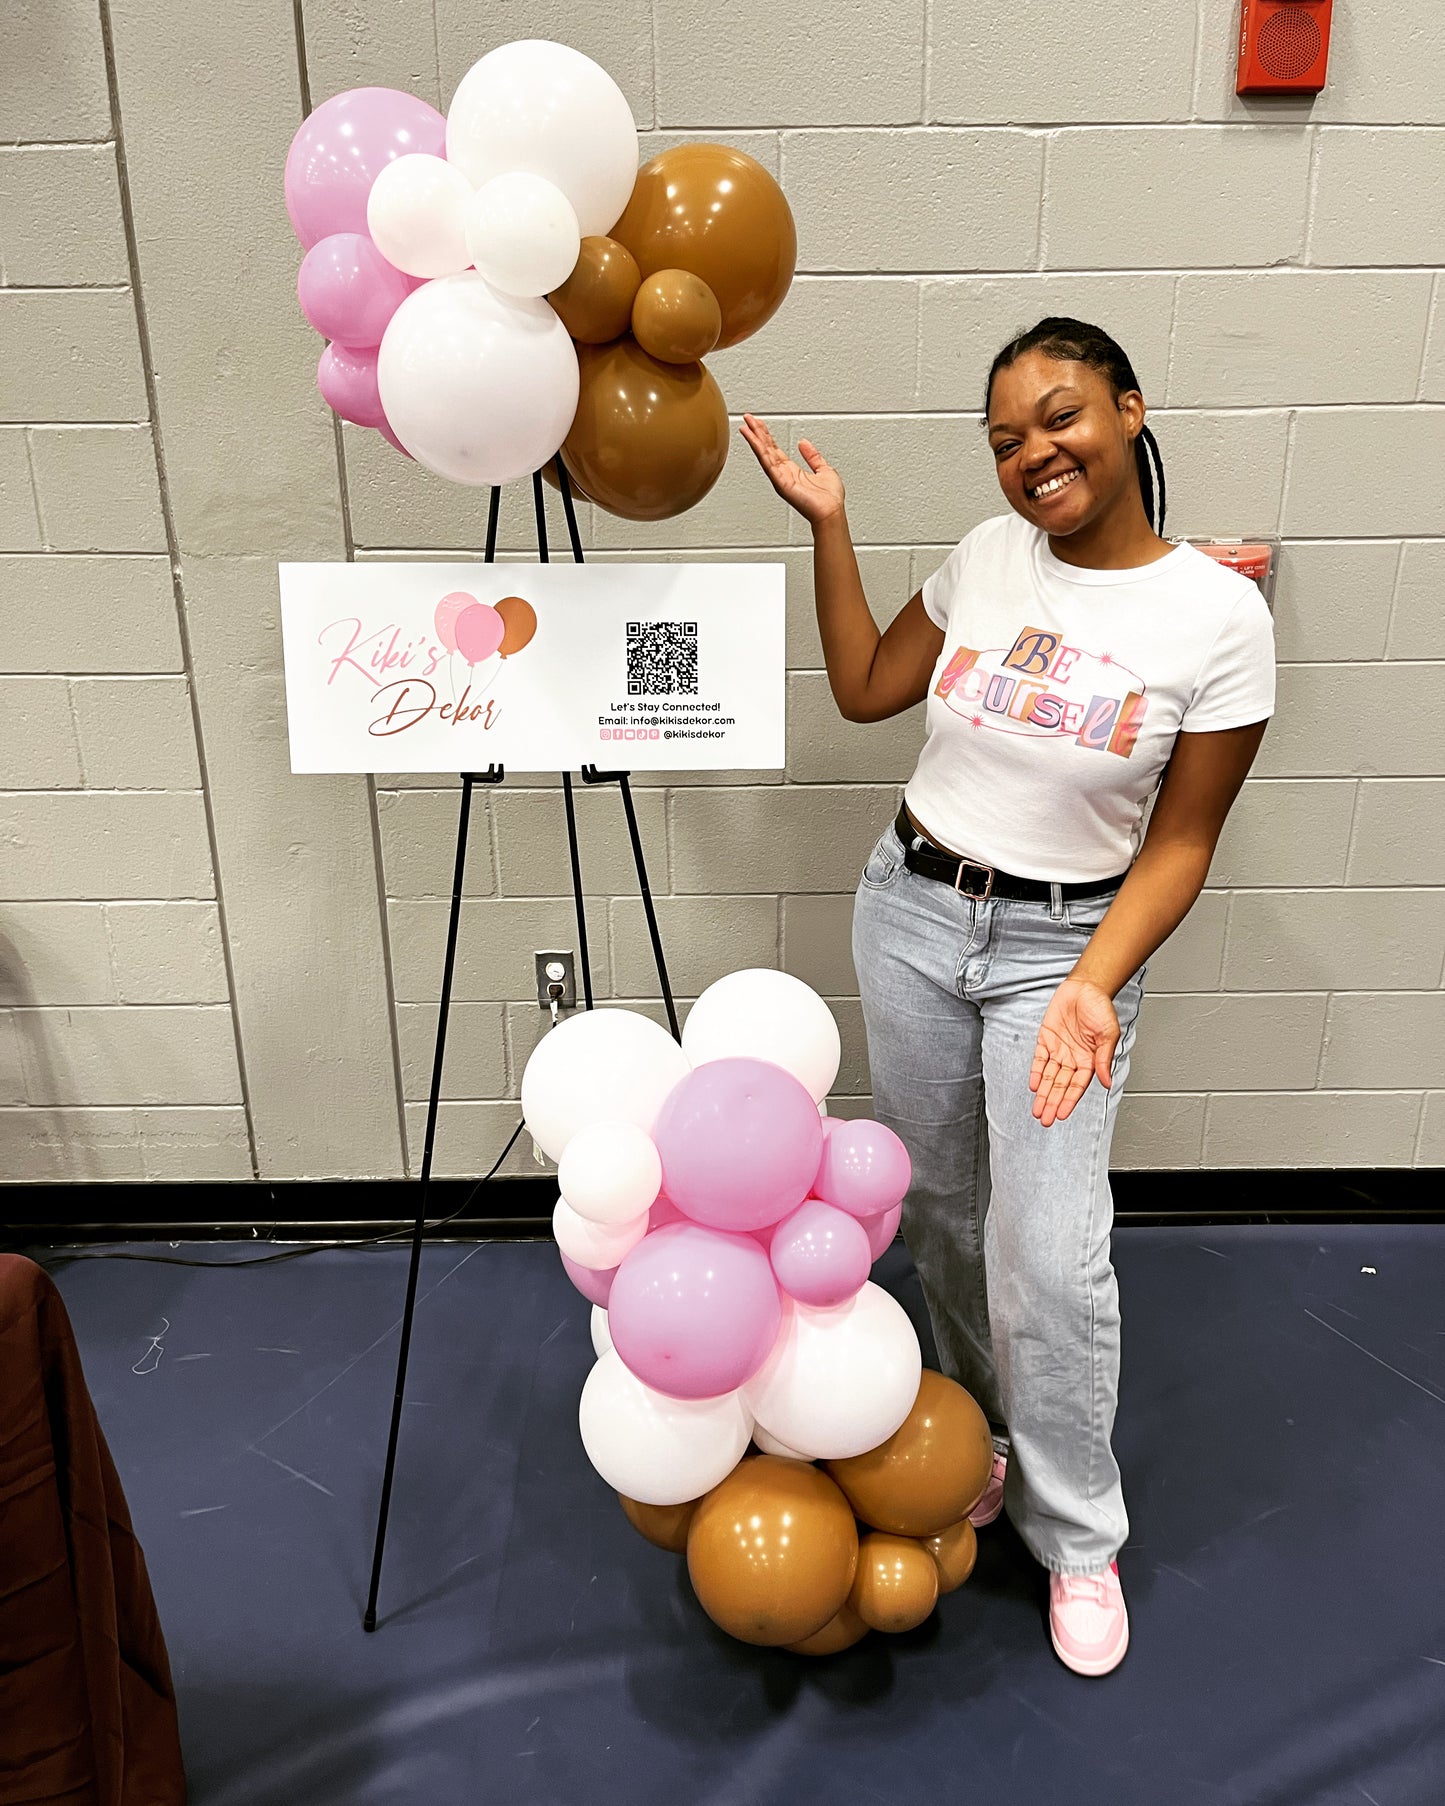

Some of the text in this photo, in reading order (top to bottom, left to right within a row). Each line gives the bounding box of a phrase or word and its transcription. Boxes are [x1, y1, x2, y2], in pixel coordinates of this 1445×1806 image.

[318, 617, 447, 687] Kiki's
[1012, 632, 1082, 685] BE
[368, 678, 502, 737] Dekor
[598, 715, 736, 727] Email: info@kikisdekor.com
[610, 702, 721, 713] Let's Stay Connected!
[663, 729, 726, 740] @kikisdekor
